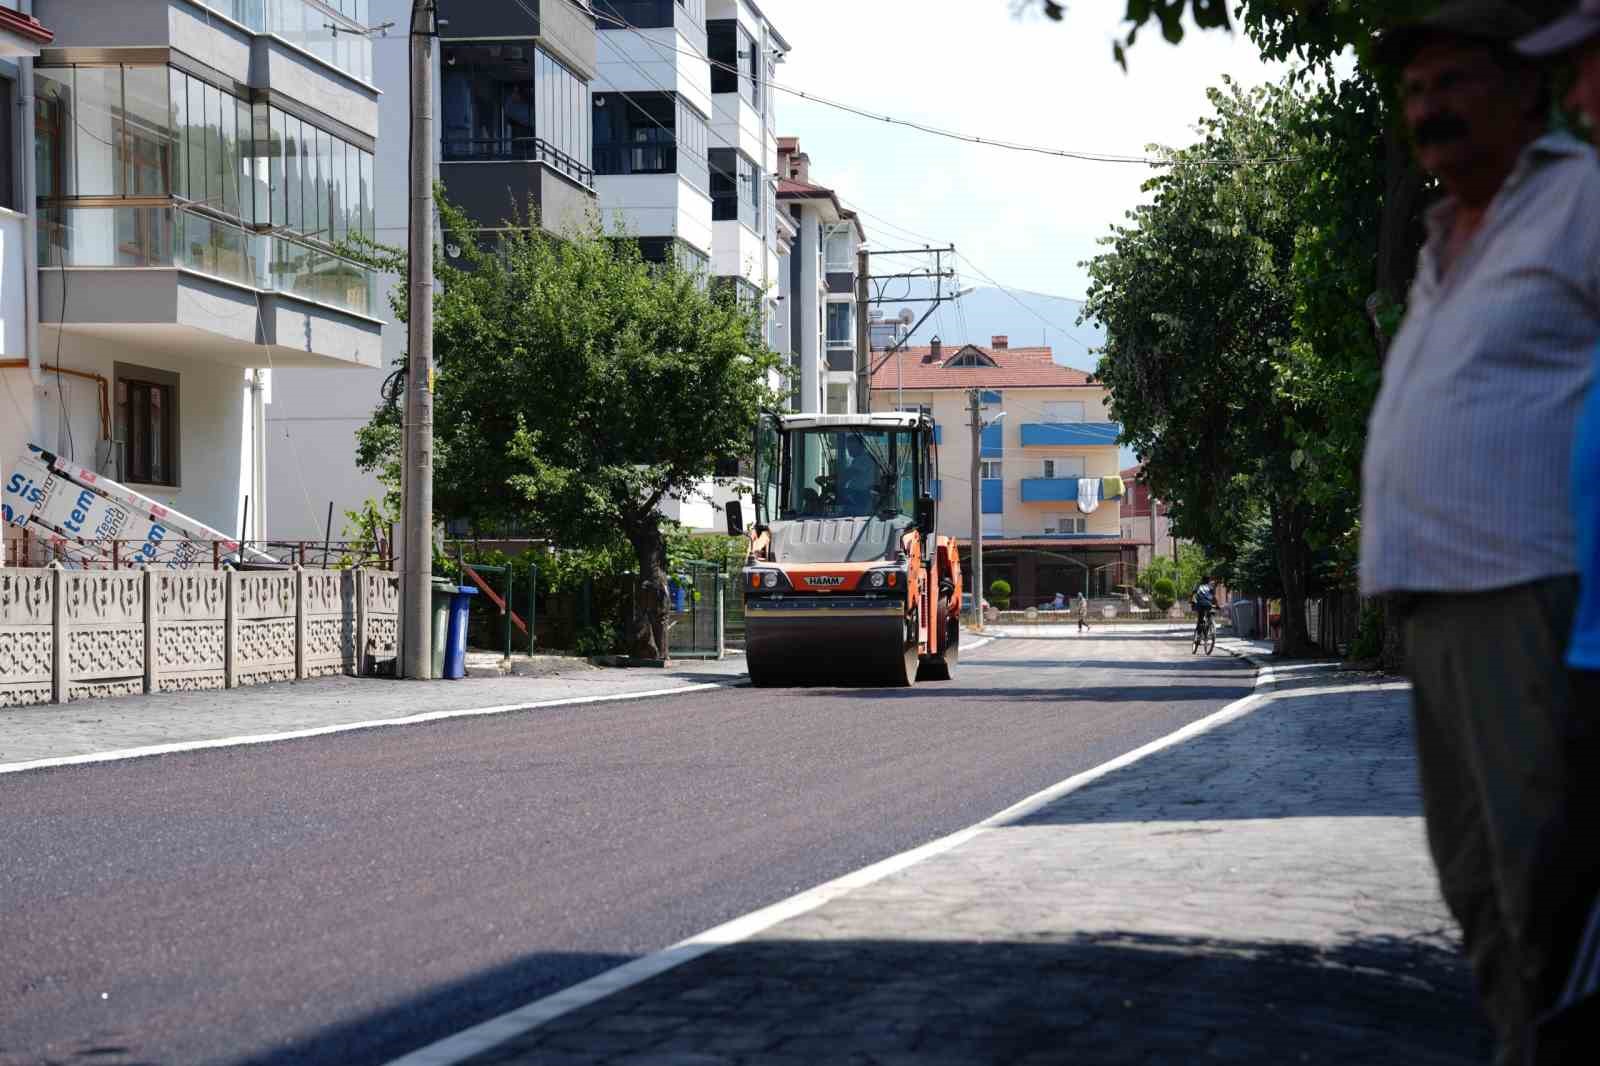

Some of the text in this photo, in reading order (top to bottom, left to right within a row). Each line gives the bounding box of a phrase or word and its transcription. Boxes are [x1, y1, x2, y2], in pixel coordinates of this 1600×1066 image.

[6, 473, 42, 503] Sis
[64, 490, 95, 533] tem
[809, 576, 840, 585] HAMM
